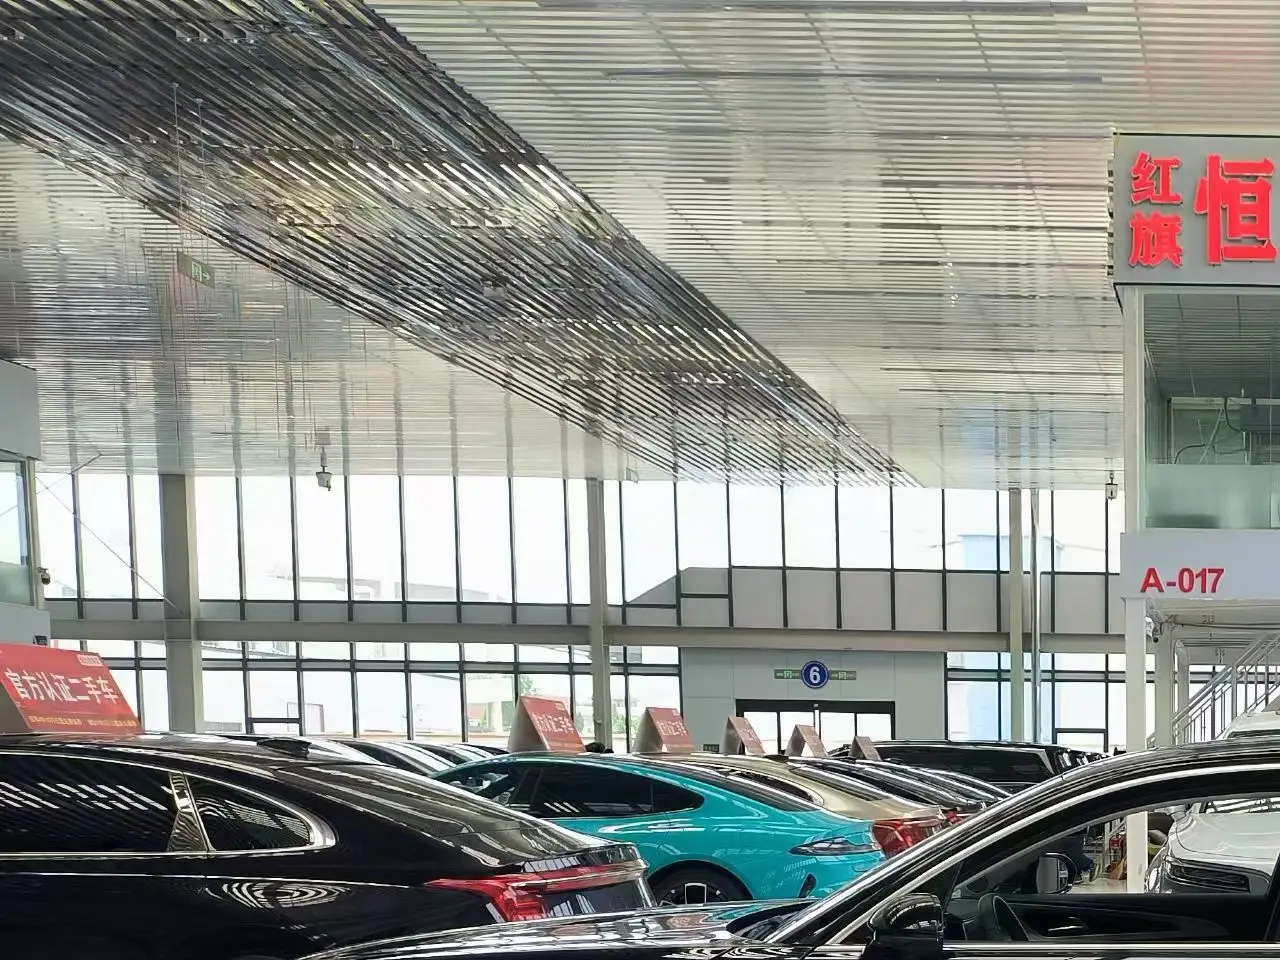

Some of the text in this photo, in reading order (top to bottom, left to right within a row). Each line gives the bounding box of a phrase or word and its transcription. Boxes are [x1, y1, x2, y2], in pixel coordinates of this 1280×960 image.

[1129, 151, 1183, 267] 红旗
[1140, 567, 1224, 593] A-017
[4, 667, 118, 705] 官方认证二手车
[809, 666, 821, 684] 6
